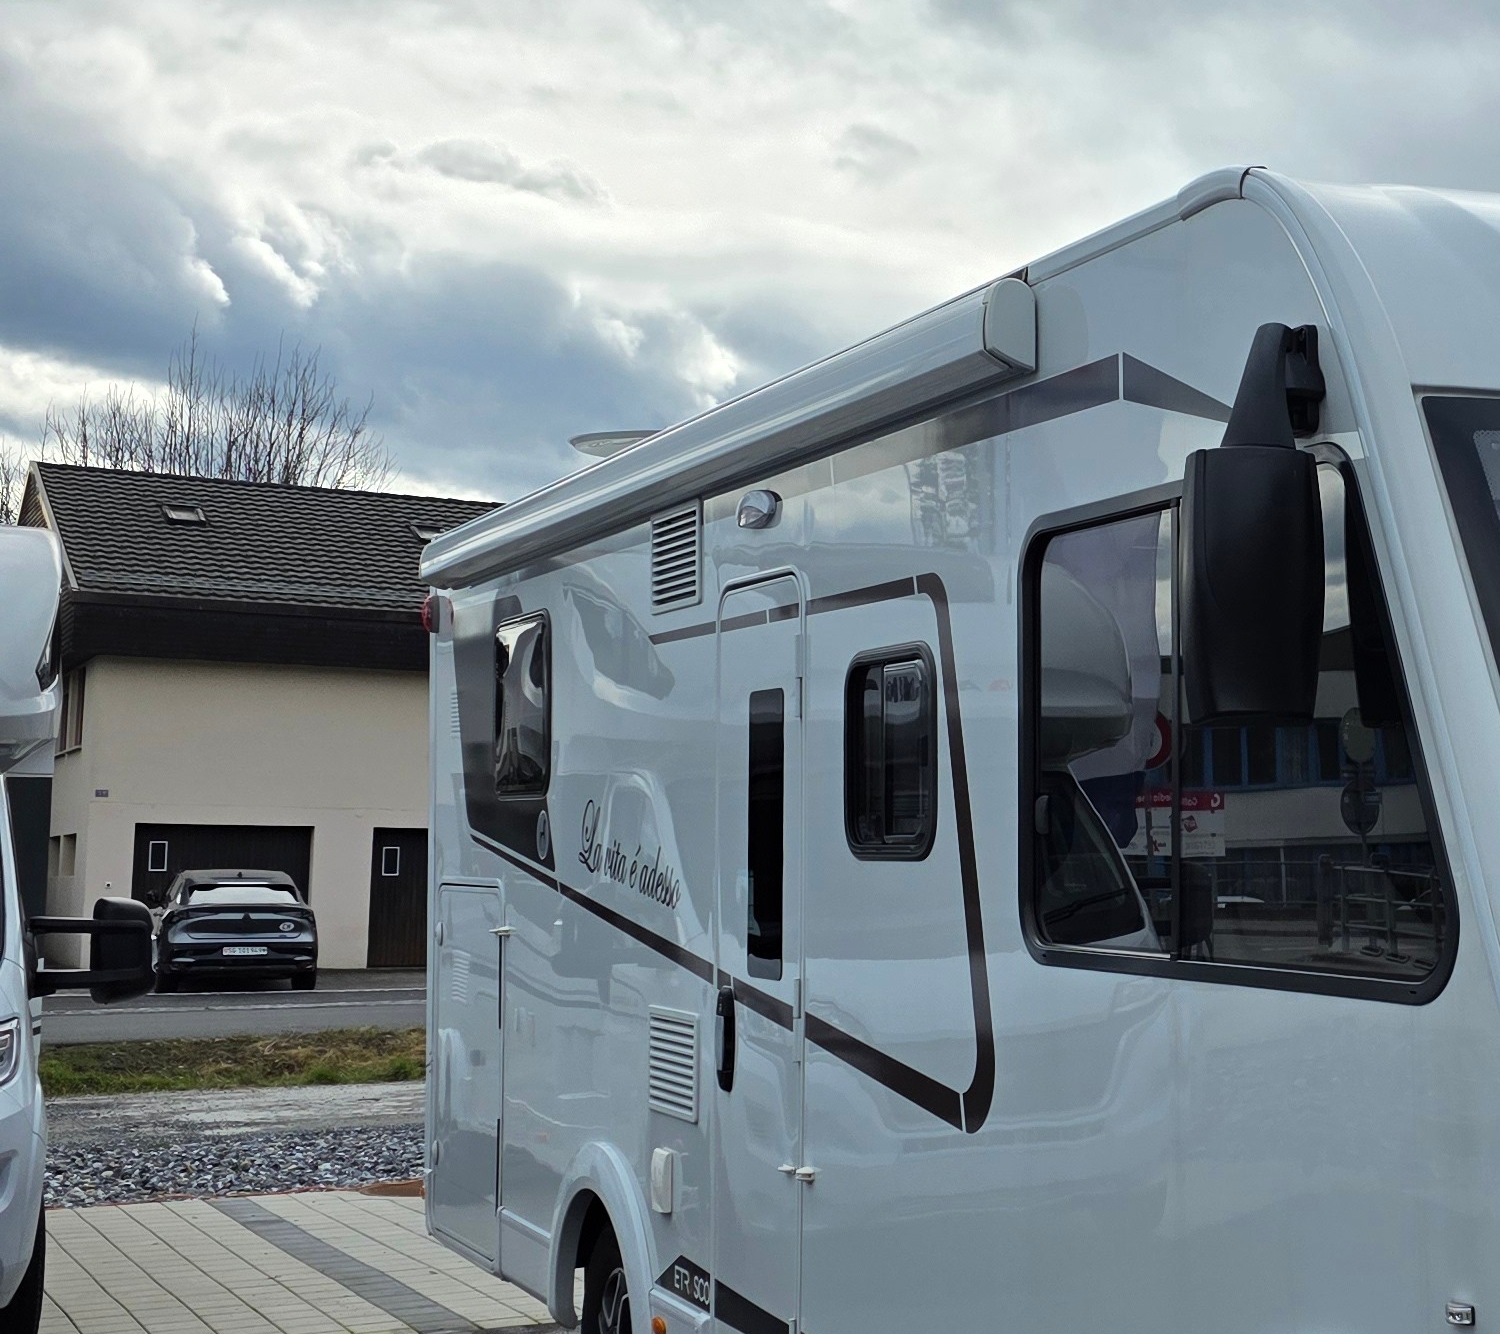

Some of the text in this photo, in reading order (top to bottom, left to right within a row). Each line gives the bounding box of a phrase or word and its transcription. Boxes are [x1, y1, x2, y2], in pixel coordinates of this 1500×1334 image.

[578, 799, 602, 873] La
[604, 839, 627, 884] vita
[639, 845, 681, 909] adesso
[674, 1265, 710, 1305] ETRSCO
